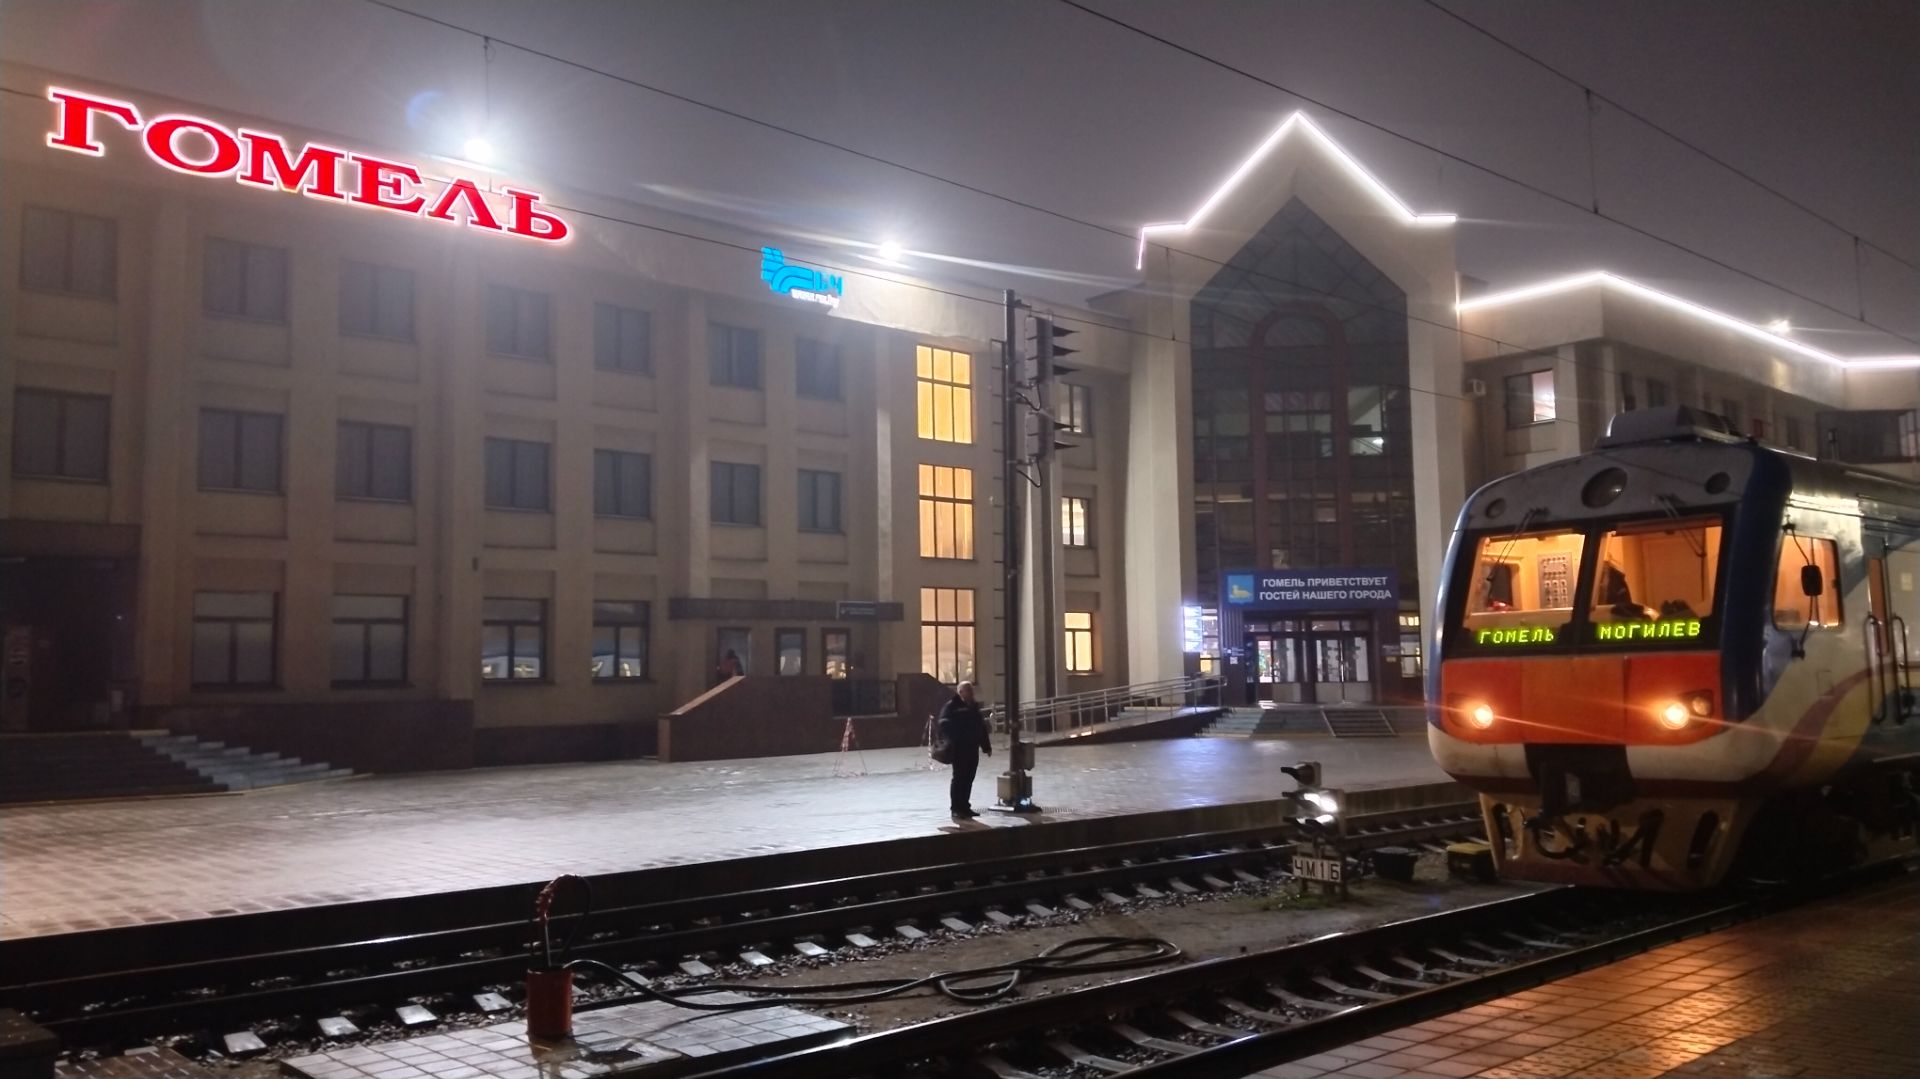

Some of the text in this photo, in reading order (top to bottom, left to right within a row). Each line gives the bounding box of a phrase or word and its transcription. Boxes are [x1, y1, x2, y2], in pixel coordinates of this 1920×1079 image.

[49, 88, 571, 242] ГОМЕЛЬ
[1262, 576, 1388, 587] ГОМЕЛЬ ПРИВЕТСТВУЕТ
[1259, 589, 1392, 601] ГОСТЕЙ НАШЕГО ГОРОДА
[1479, 628, 1555, 645] ГОМЕЛЬ
[1599, 621, 1701, 641] МОГИЛЕВ
